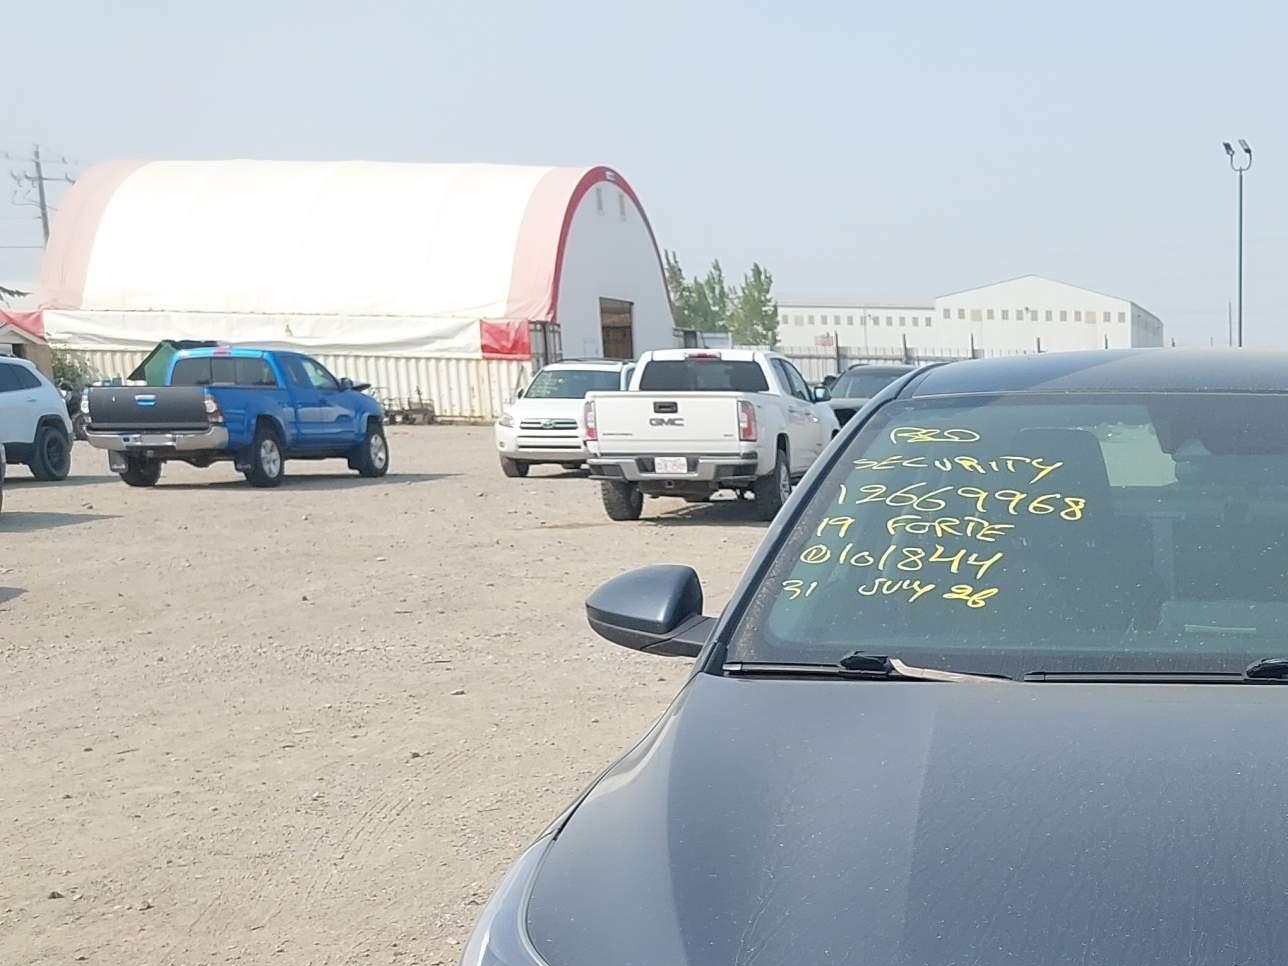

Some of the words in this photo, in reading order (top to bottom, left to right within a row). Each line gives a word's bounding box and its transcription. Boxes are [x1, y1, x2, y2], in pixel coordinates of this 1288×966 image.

[648, 418, 685, 427] GMC
[853, 455, 1064, 485] SECURITY
[836, 482, 1087, 521] 12669968
[816, 516, 856, 538] 19
[886, 514, 1016, 542] FORTE
[782, 579, 819, 600] 31
